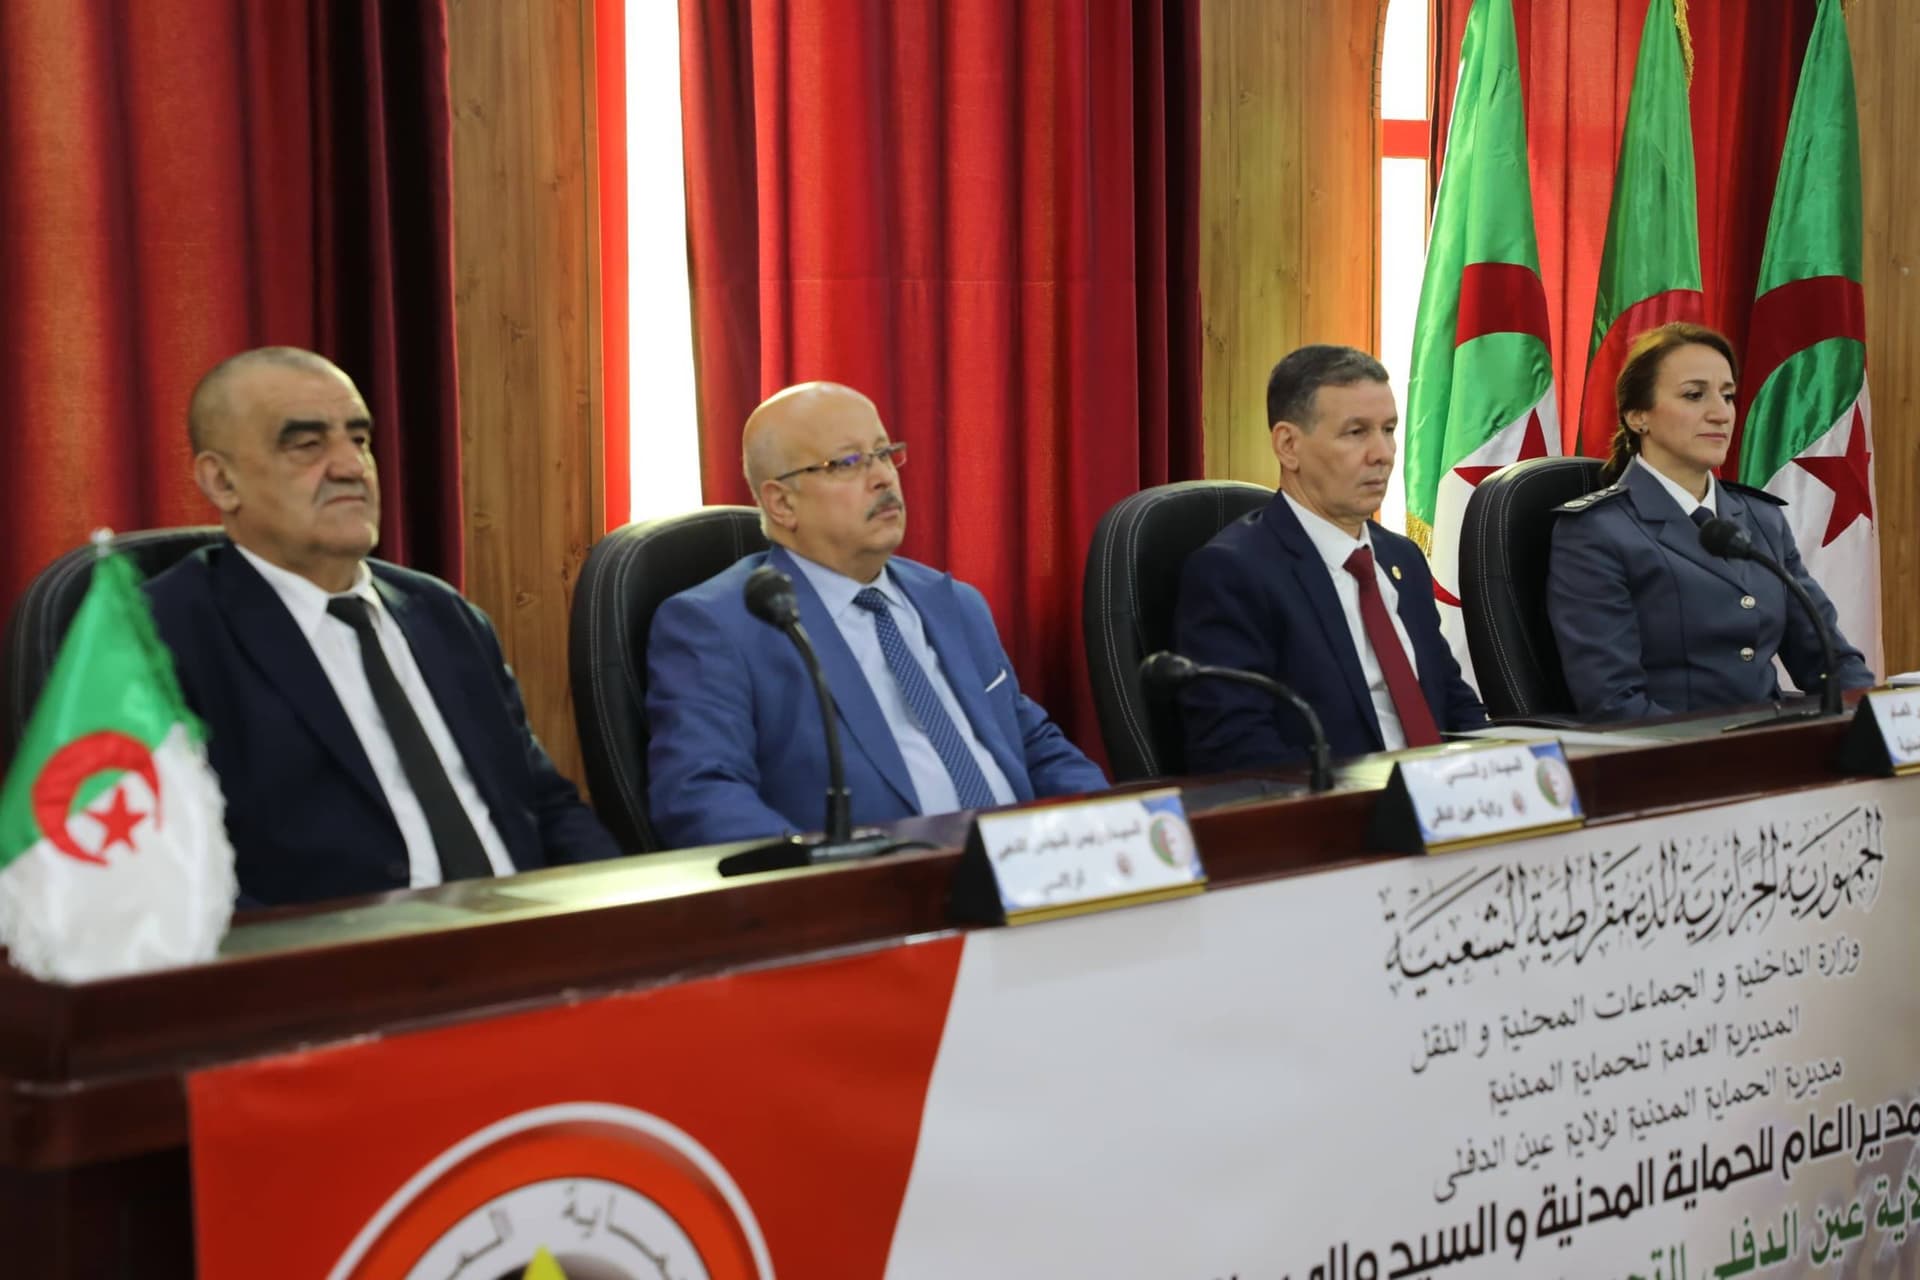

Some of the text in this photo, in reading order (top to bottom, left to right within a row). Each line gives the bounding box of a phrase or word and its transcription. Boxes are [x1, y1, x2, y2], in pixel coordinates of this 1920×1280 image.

[1410, 936, 1861, 1075] وزارة الداخلية و الجماعات المحلية و النقل
[1488, 1004, 1800, 1118] المديرية العامة للحماية المدنية
[1434, 1060, 1842, 1204] مديرية الحماية المدنية لولاية عين الدفلى
[1663, 1125, 1774, 1211] للحماية
[1782, 1102, 1853, 1180] العام
[1388, 1201, 1498, 1280] السيد
[1505, 1207, 1528, 1262] و
[1536, 1156, 1656, 1248] المدنية
[1811, 1202, 1864, 1265] عين
